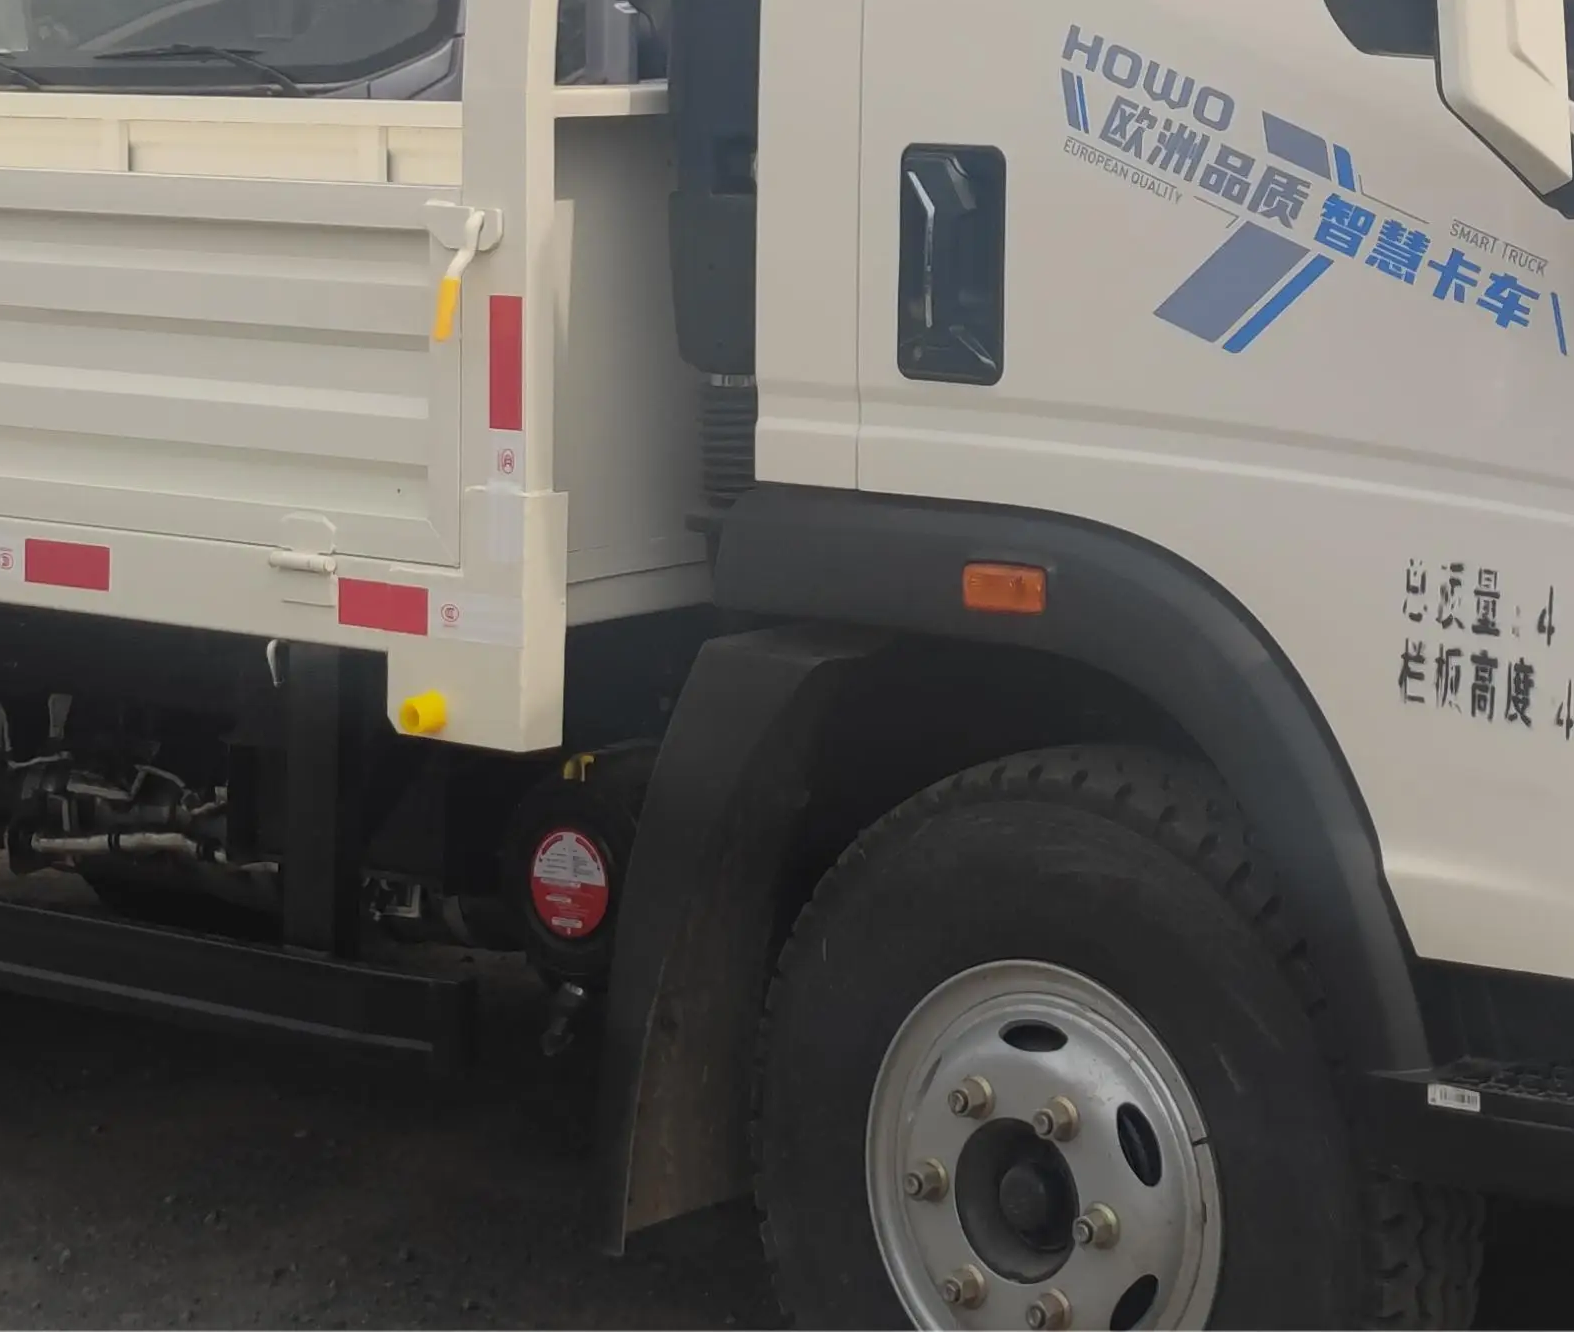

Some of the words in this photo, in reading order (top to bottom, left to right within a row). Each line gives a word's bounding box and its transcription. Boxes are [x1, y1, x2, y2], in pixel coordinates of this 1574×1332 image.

[1062, 24, 1234, 131] HOWO
[1063, 138, 1128, 181] EUROPEAN
[1131, 170, 1183, 205] QUALITY
[1099, 95, 1312, 228] 欧洲品质
[1314, 193, 1541, 329] 智慧卡车
[1450, 222, 1499, 254] SMART
[1502, 242, 1549, 277] TRUCK
